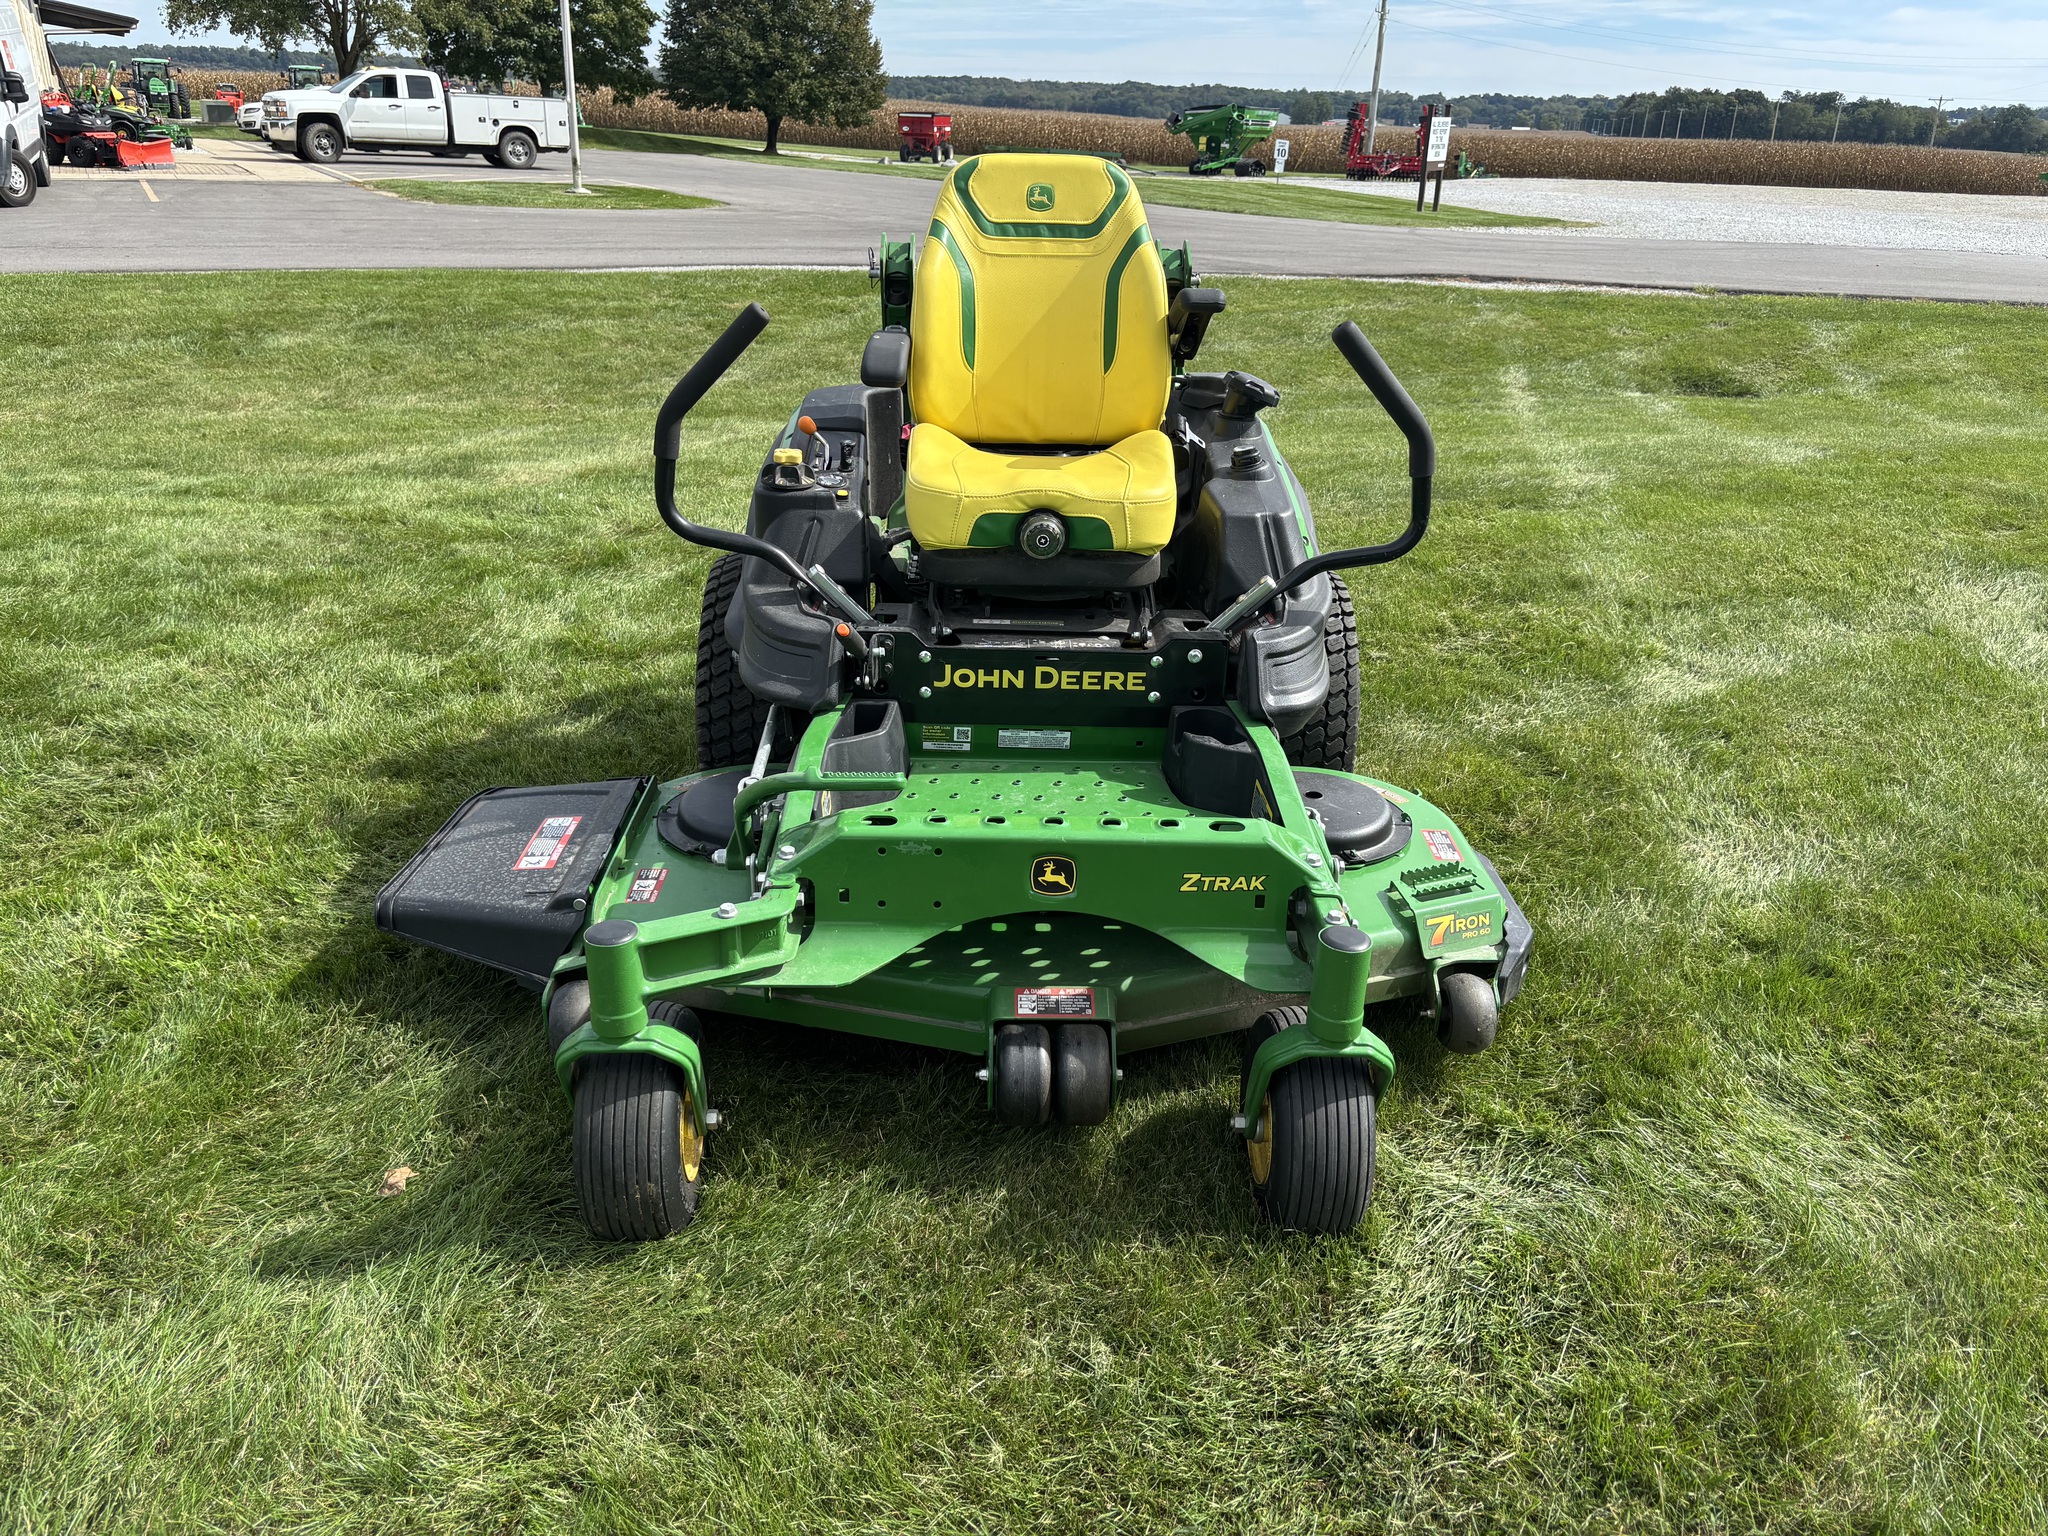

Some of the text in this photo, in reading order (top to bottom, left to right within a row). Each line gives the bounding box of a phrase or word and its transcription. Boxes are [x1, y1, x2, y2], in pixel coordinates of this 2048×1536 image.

[1276, 148, 1287, 158] 10
[933, 664, 1147, 691] JOHN DEERE
[1180, 873, 1268, 891] ZTRAK
[1462, 927, 1491, 939] PRO 60
